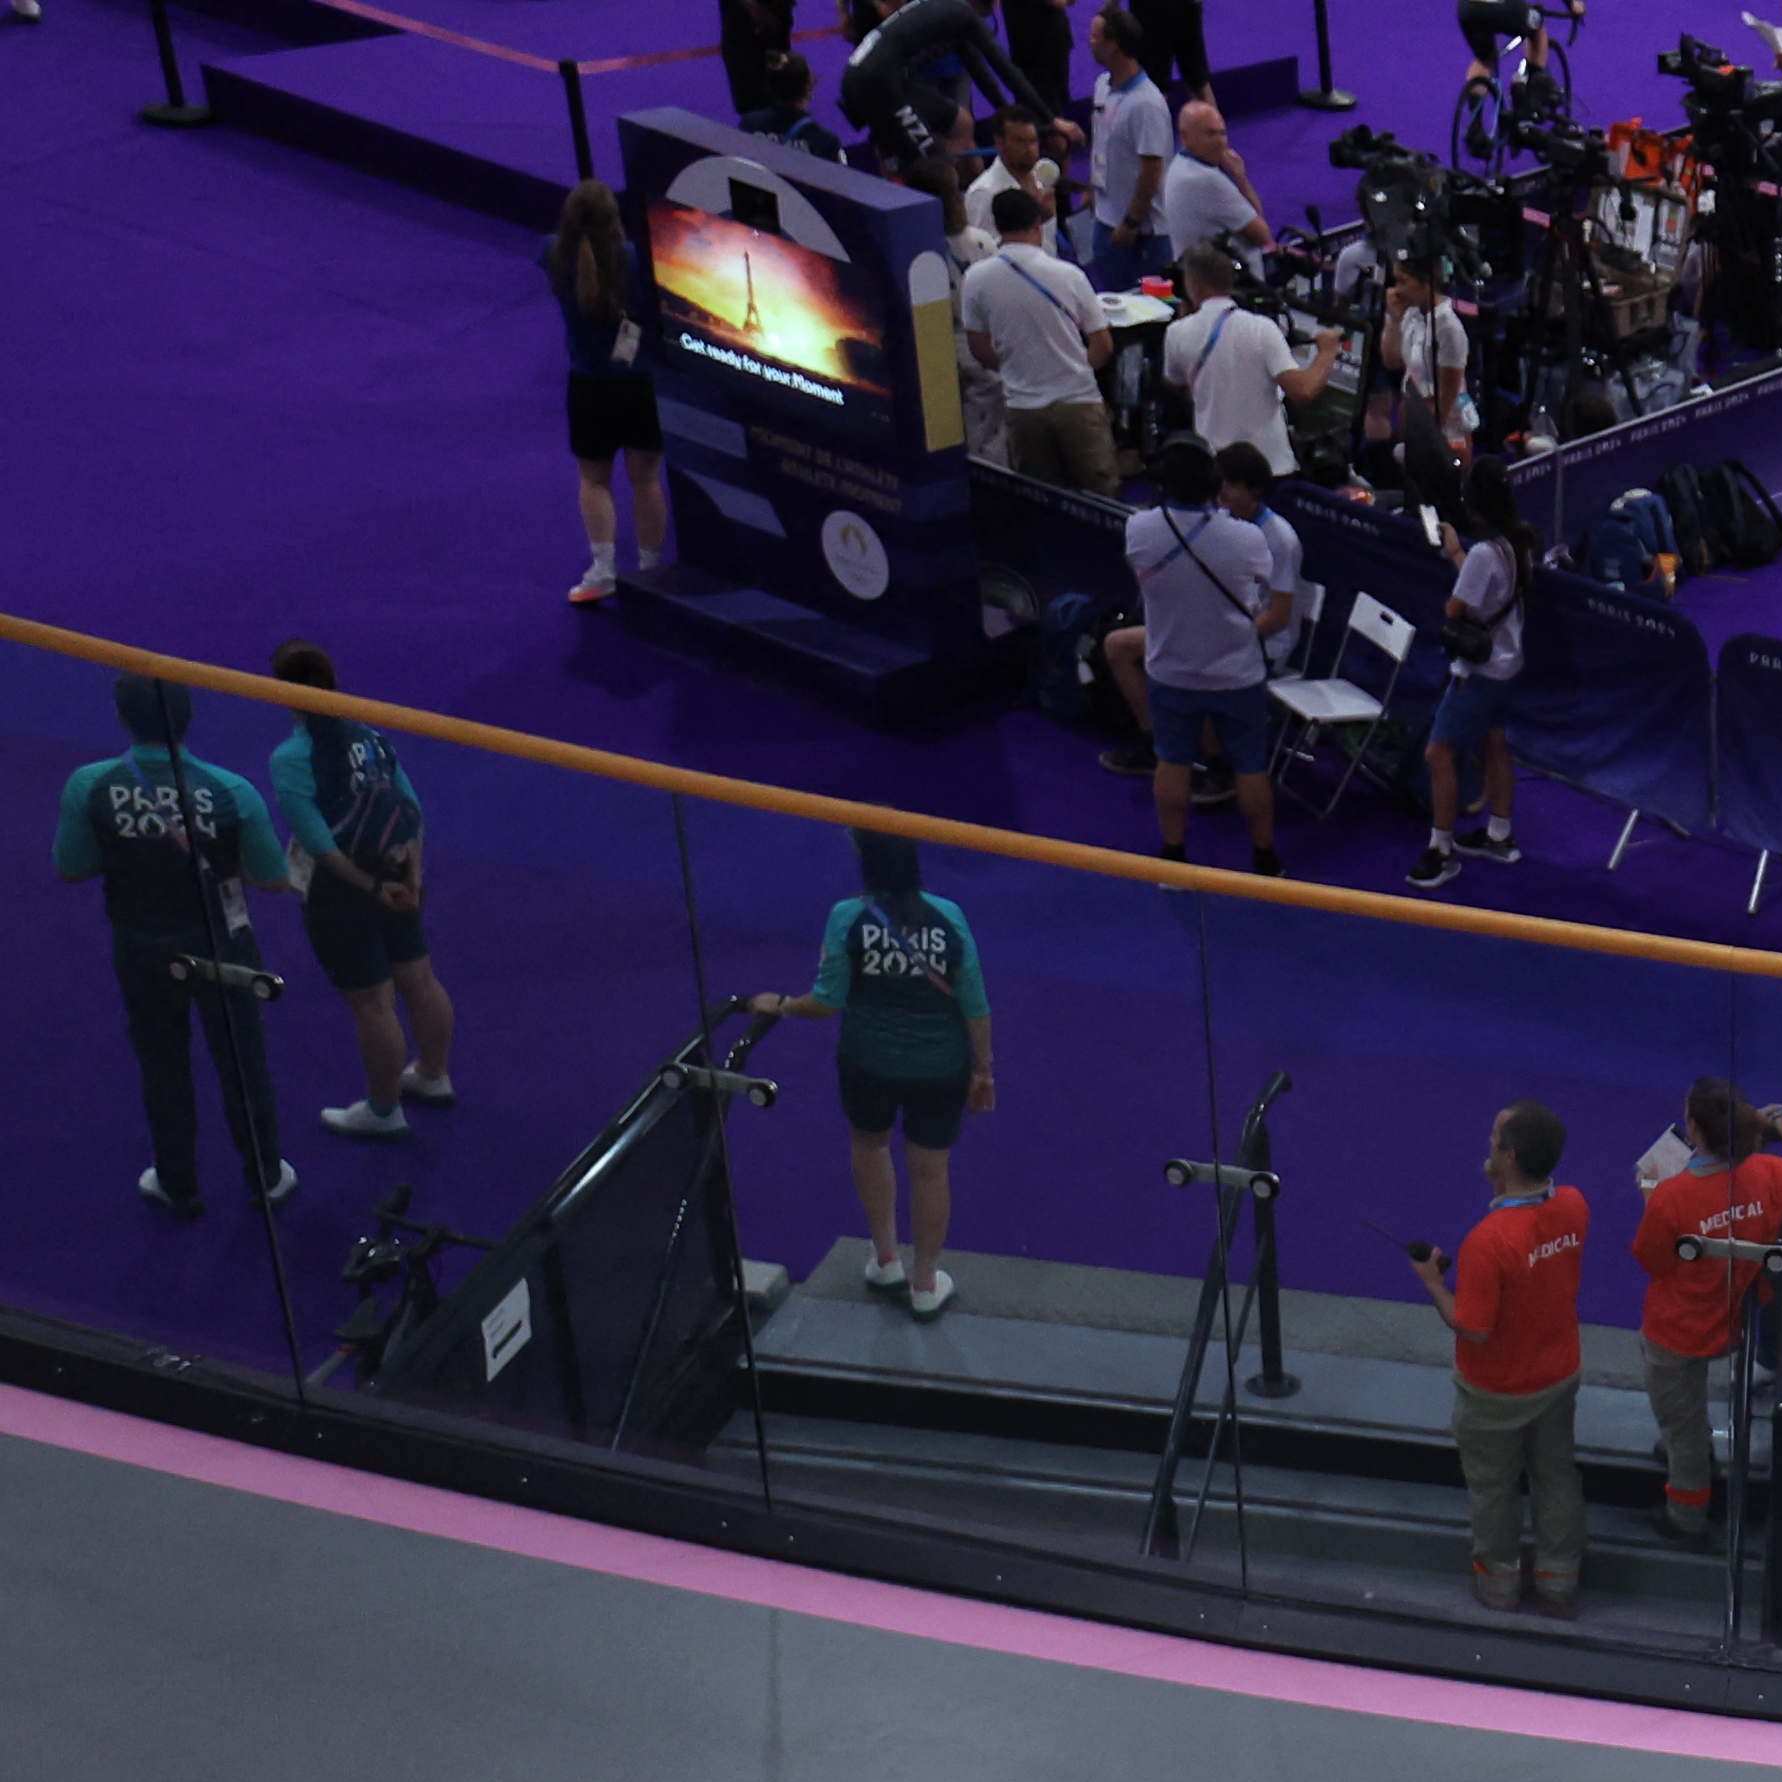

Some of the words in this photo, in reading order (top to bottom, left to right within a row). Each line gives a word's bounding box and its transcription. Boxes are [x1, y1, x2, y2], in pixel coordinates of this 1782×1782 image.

[895, 104, 935, 158] NZL
[679, 332, 706, 356] Get
[706, 344, 742, 371] ready
[741, 354, 762, 378] for
[761, 364, 791, 388] your
[791, 372, 845, 406] Moment
[109, 784, 214, 814] PARS
[862, 949, 948, 977] 2024
[1699, 1200, 1764, 1235] MEDICAL
